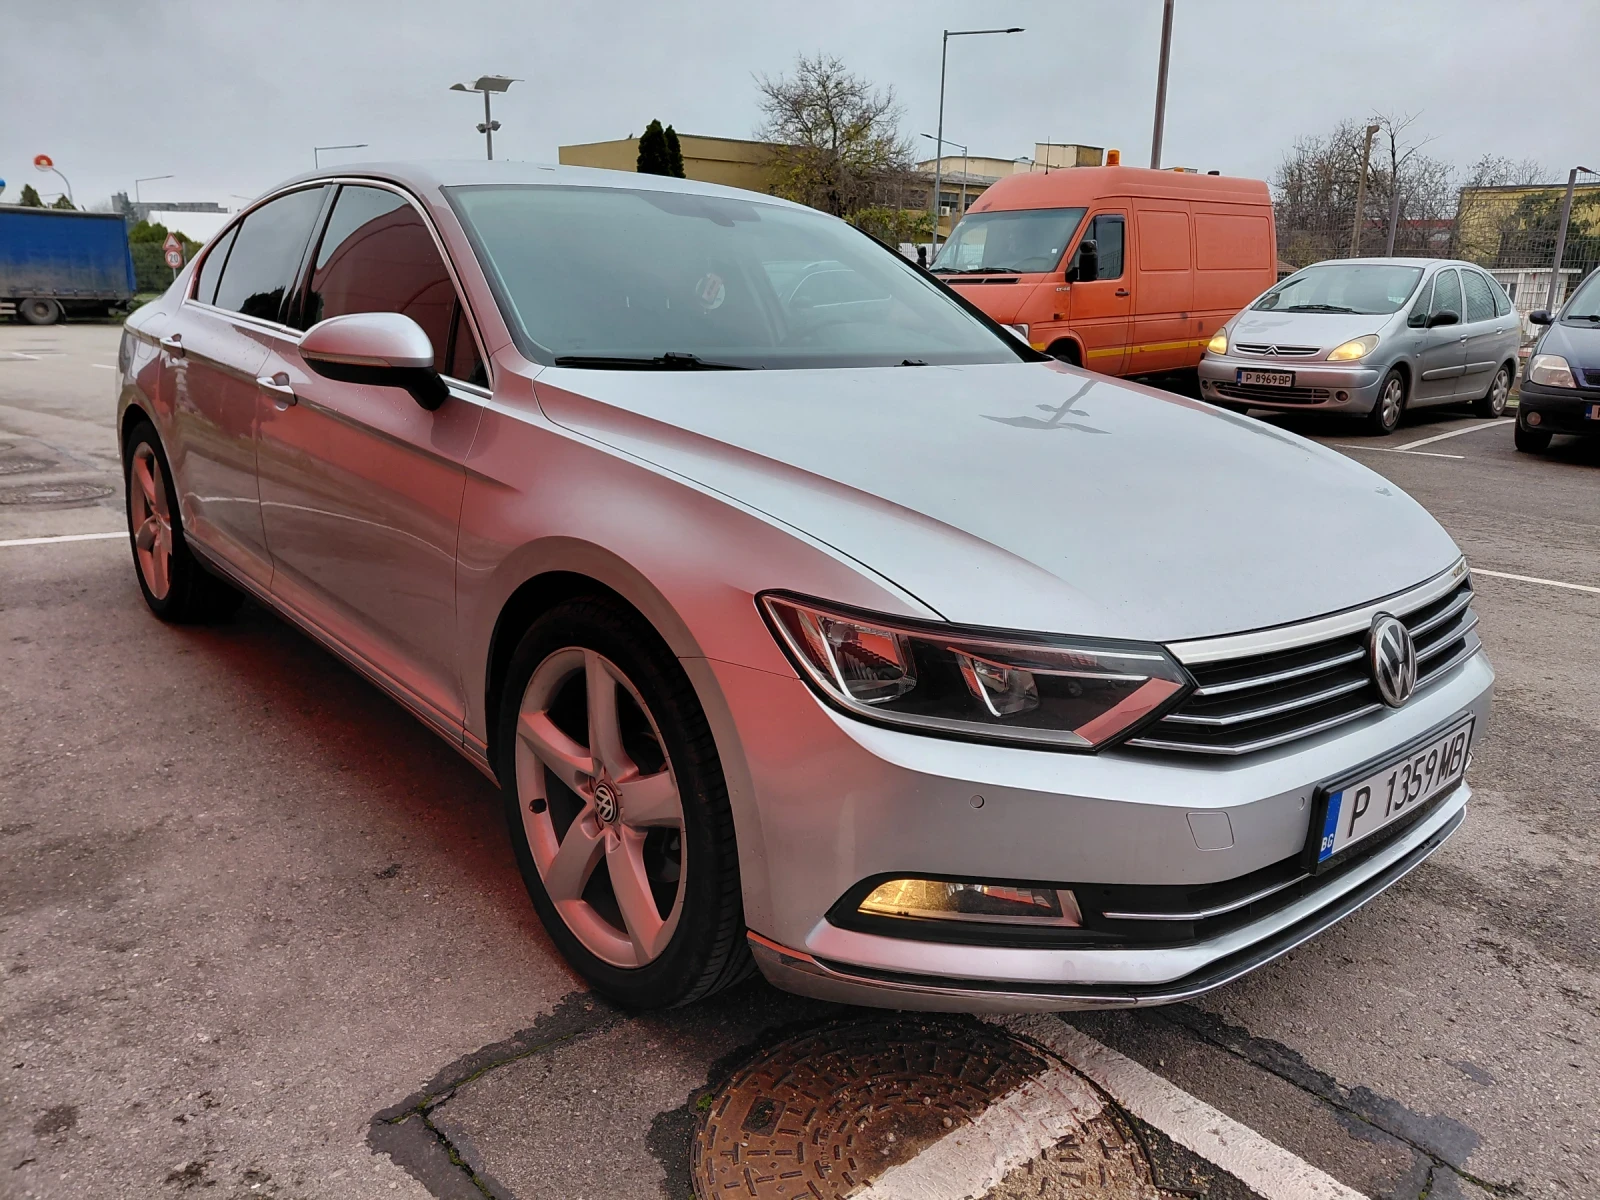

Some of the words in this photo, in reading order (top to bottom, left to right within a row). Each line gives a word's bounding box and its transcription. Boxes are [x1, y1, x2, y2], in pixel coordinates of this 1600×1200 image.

[169, 253, 179, 263] 20
[1245, 373, 1252, 383] P
[1348, 785, 1371, 838] P
[1320, 833, 1334, 853] BG
